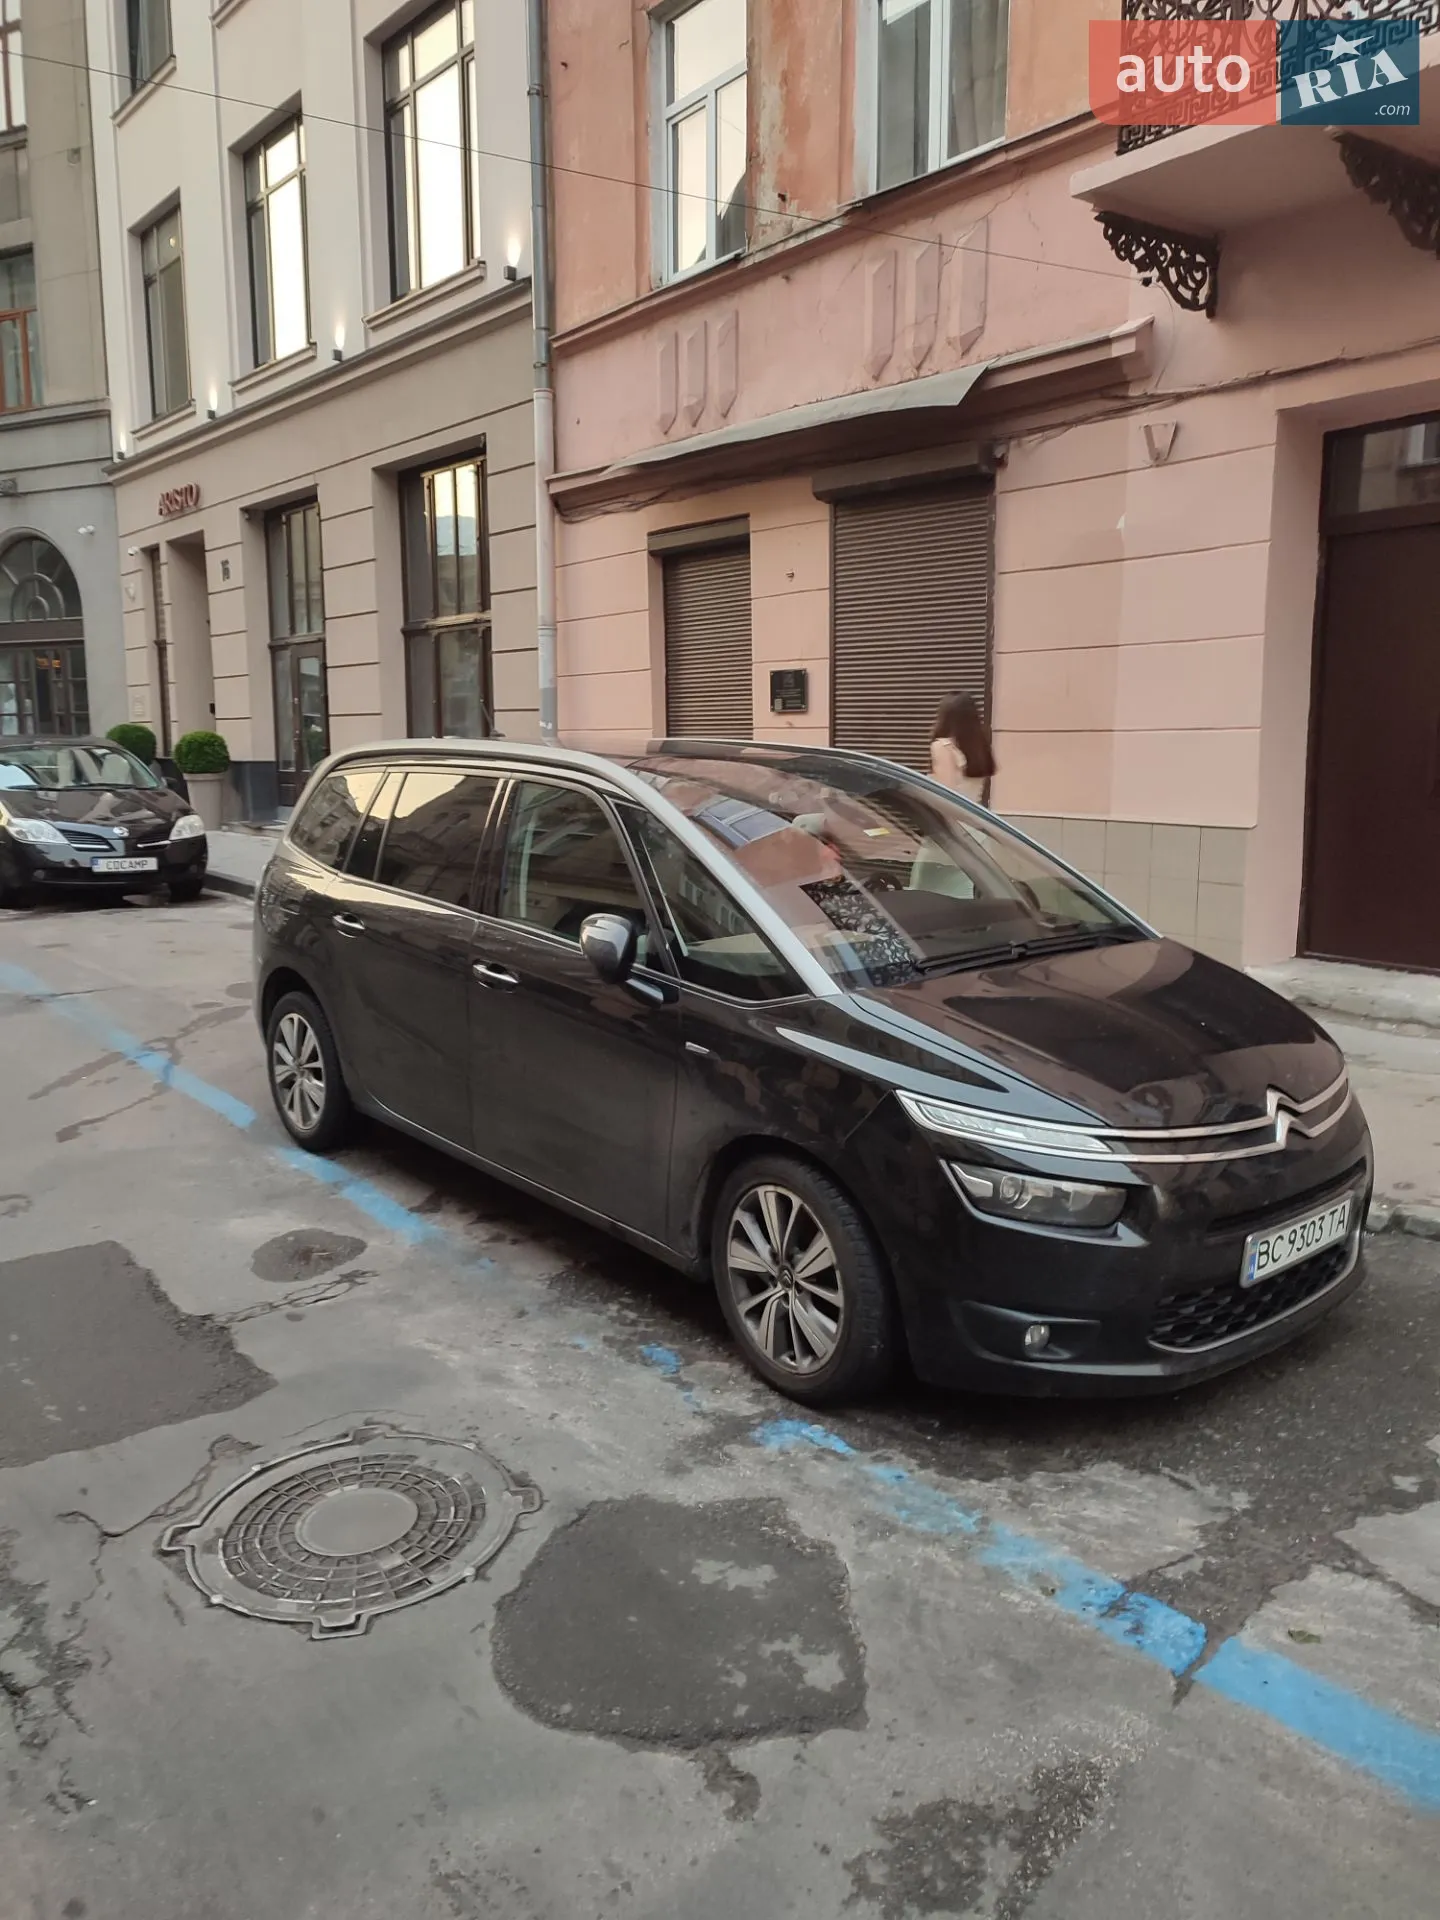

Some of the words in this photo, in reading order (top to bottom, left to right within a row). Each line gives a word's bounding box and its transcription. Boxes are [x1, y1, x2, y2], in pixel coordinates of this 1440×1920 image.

[1257, 1235, 1284, 1270] BC
[1287, 1216, 1325, 1257] 9303
[1329, 1205, 1346, 1236] TA
